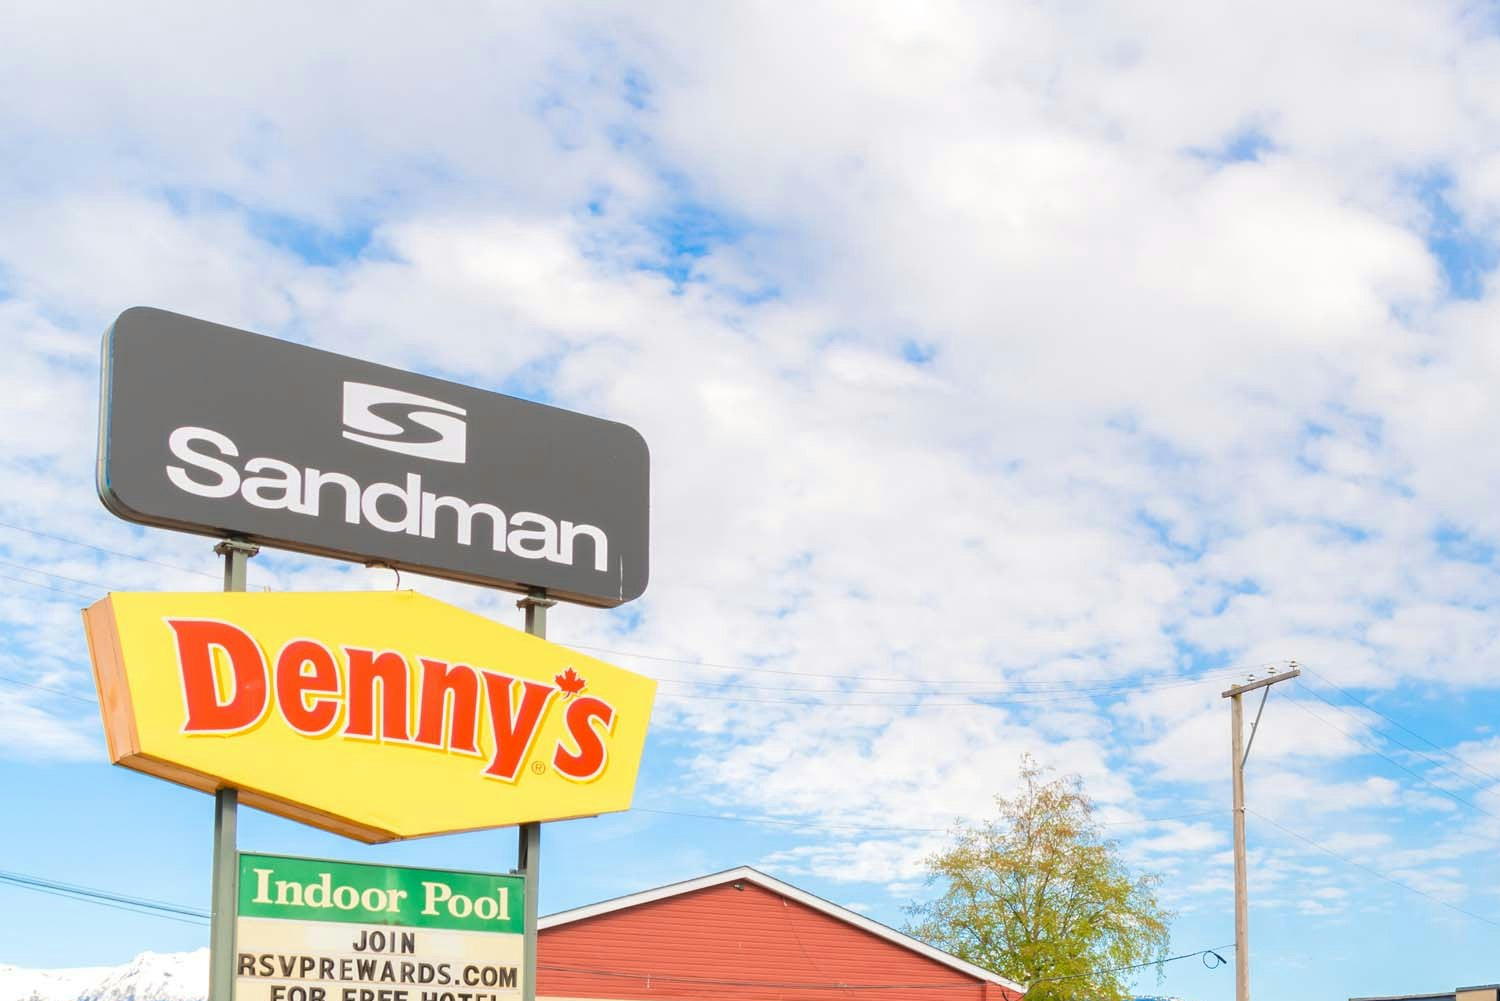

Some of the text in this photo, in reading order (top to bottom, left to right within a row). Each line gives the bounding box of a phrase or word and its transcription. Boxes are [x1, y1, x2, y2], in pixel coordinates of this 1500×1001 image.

[166, 426, 608, 571] Sandman
[163, 617, 616, 784] Denny's
[252, 868, 511, 921] Indoor Pool
[352, 930, 415, 954] JOIN
[237, 953, 518, 988] RSVPREWARDS.COM
